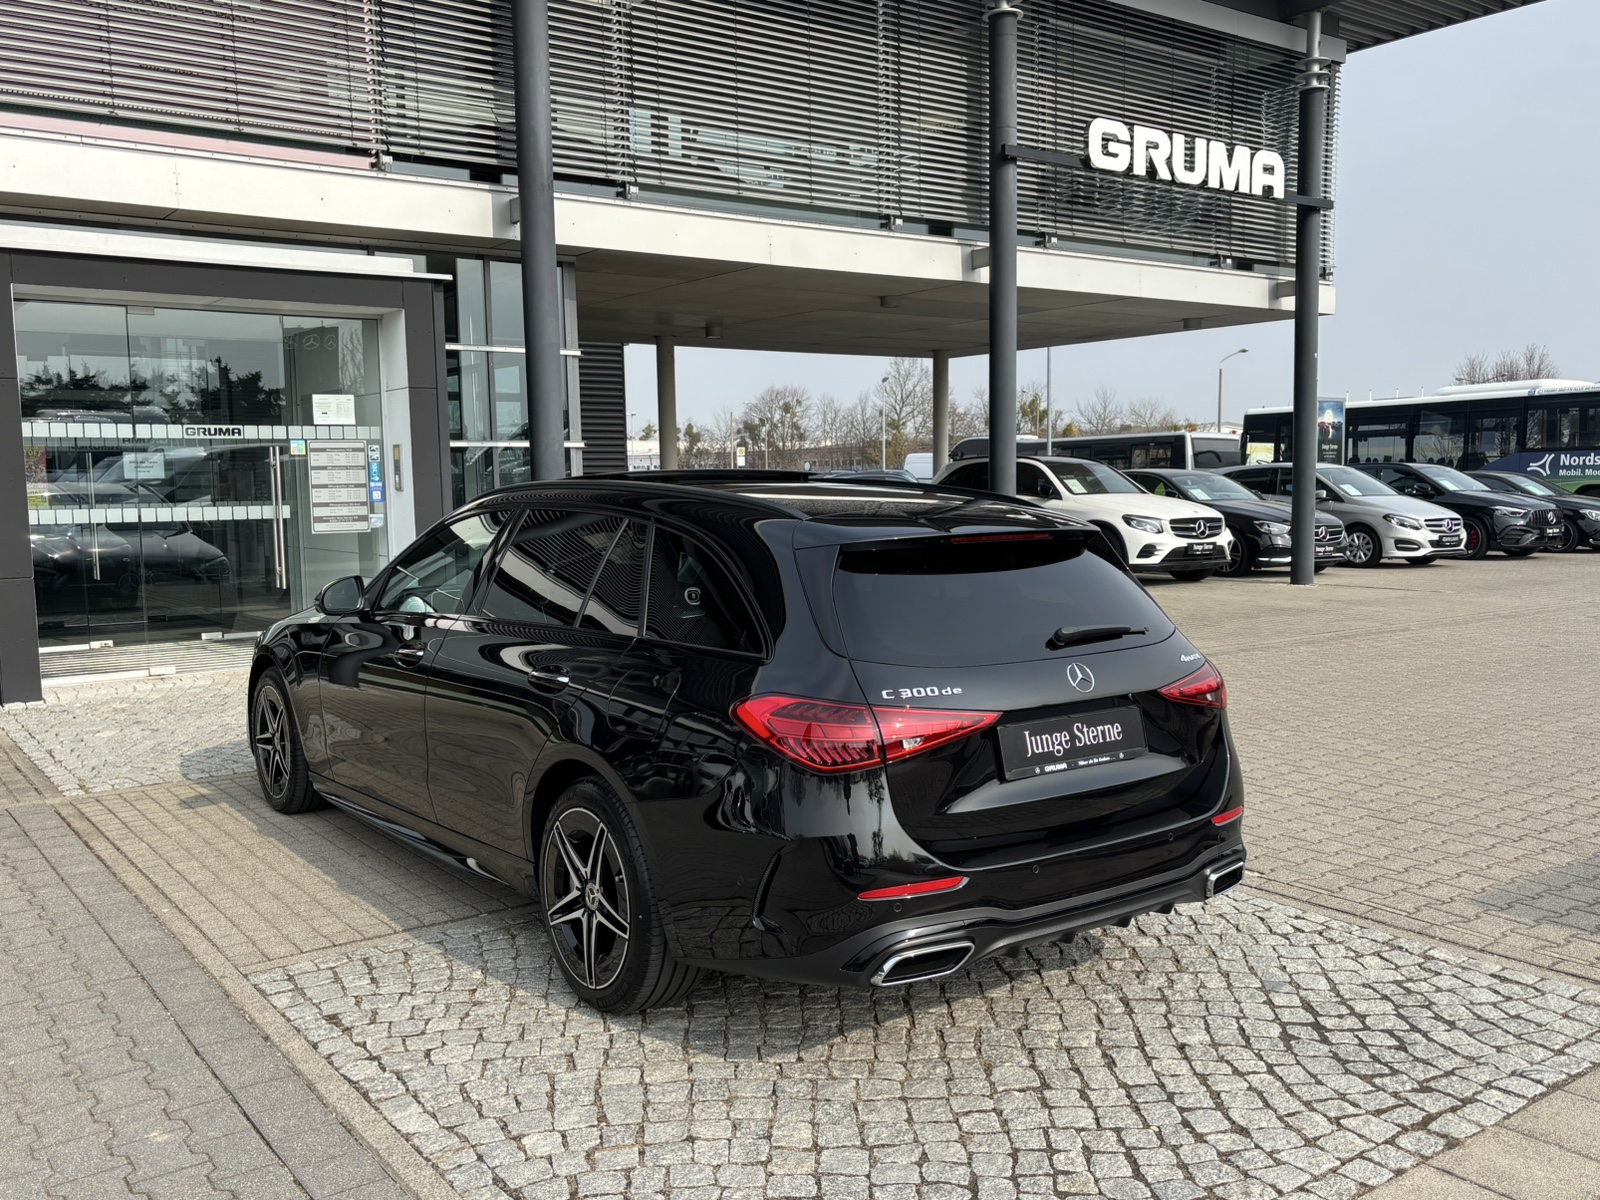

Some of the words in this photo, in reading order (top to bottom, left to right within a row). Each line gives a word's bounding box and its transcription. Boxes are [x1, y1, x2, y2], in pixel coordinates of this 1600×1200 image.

[1088, 117, 1285, 199] GRUMA
[185, 427, 242, 437] GRUMA
[1560, 452, 1600, 466] Nords
[1559, 468, 1583, 477] Mobil.
[881, 689, 895, 699] C
[898, 686, 939, 699] 300
[941, 686, 962, 695] de
[1023, 730, 1071, 757] Junge
[1073, 722, 1123, 747] Sterne
[1044, 762, 1067, 772] GRUMA
